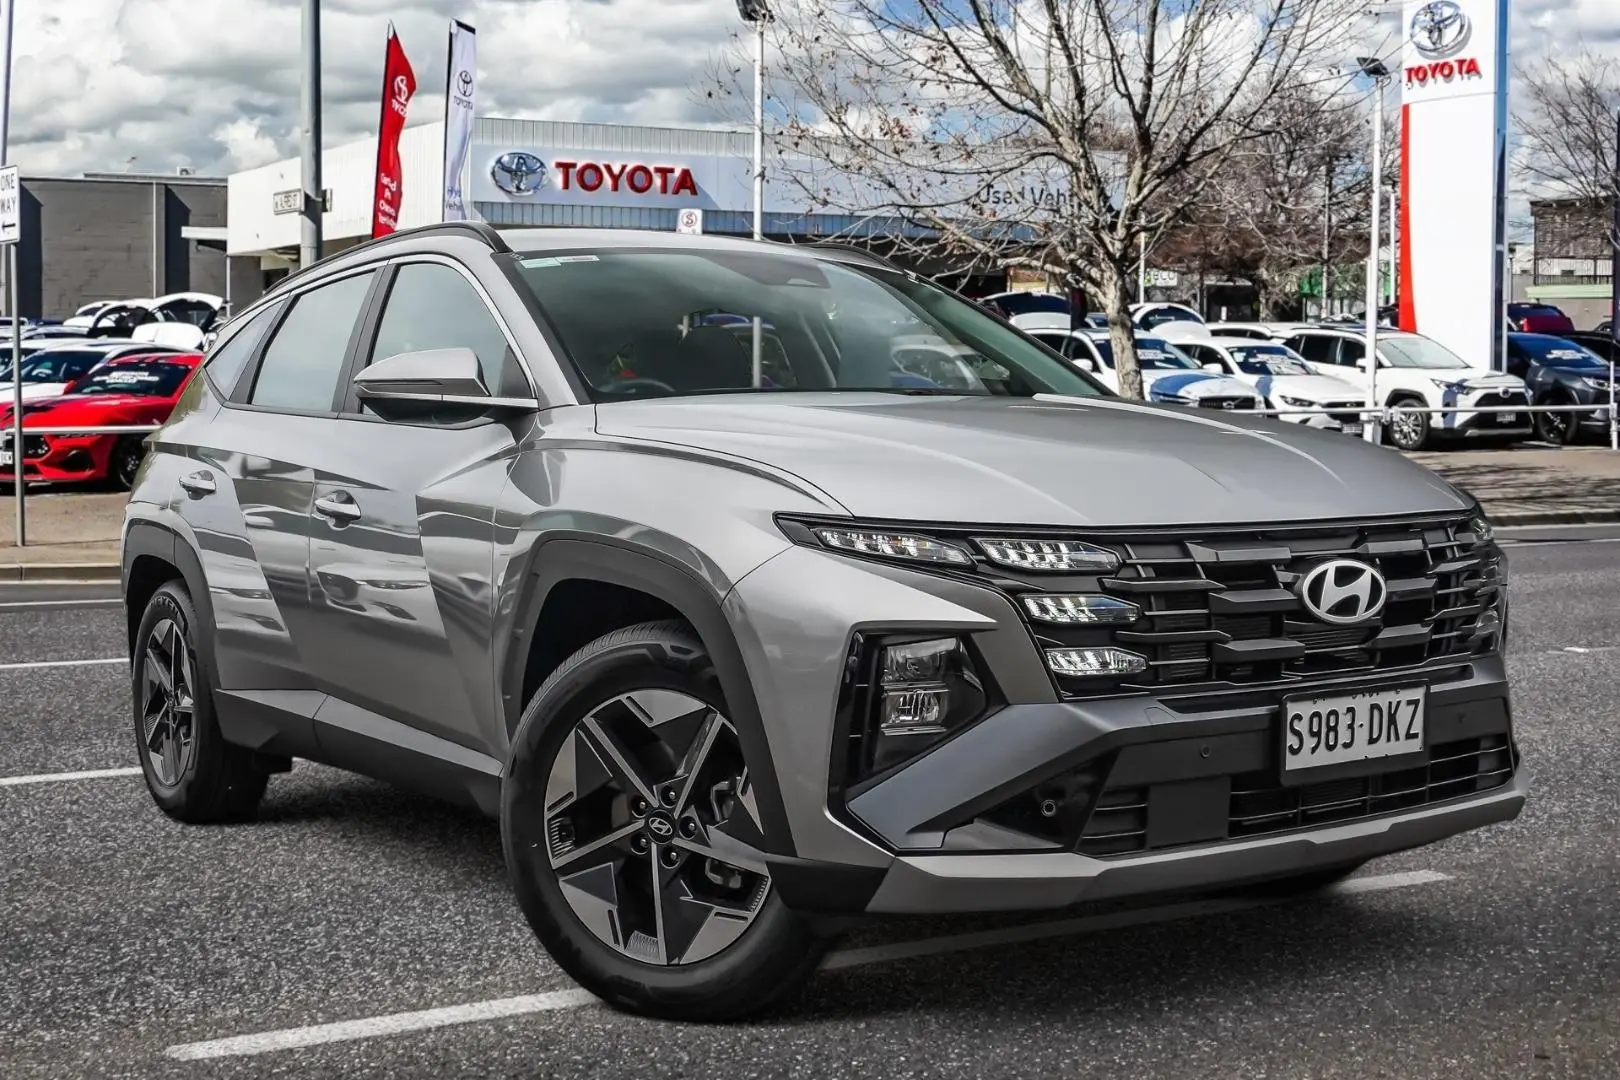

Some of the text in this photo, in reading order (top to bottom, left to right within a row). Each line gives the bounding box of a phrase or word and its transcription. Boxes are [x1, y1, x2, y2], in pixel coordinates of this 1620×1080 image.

[1404, 58, 1480, 83] TOYOTA
[1, 173, 15, 192] ONE
[555, 162, 698, 196] TOYOTA
[1, 196, 16, 214] WAY
